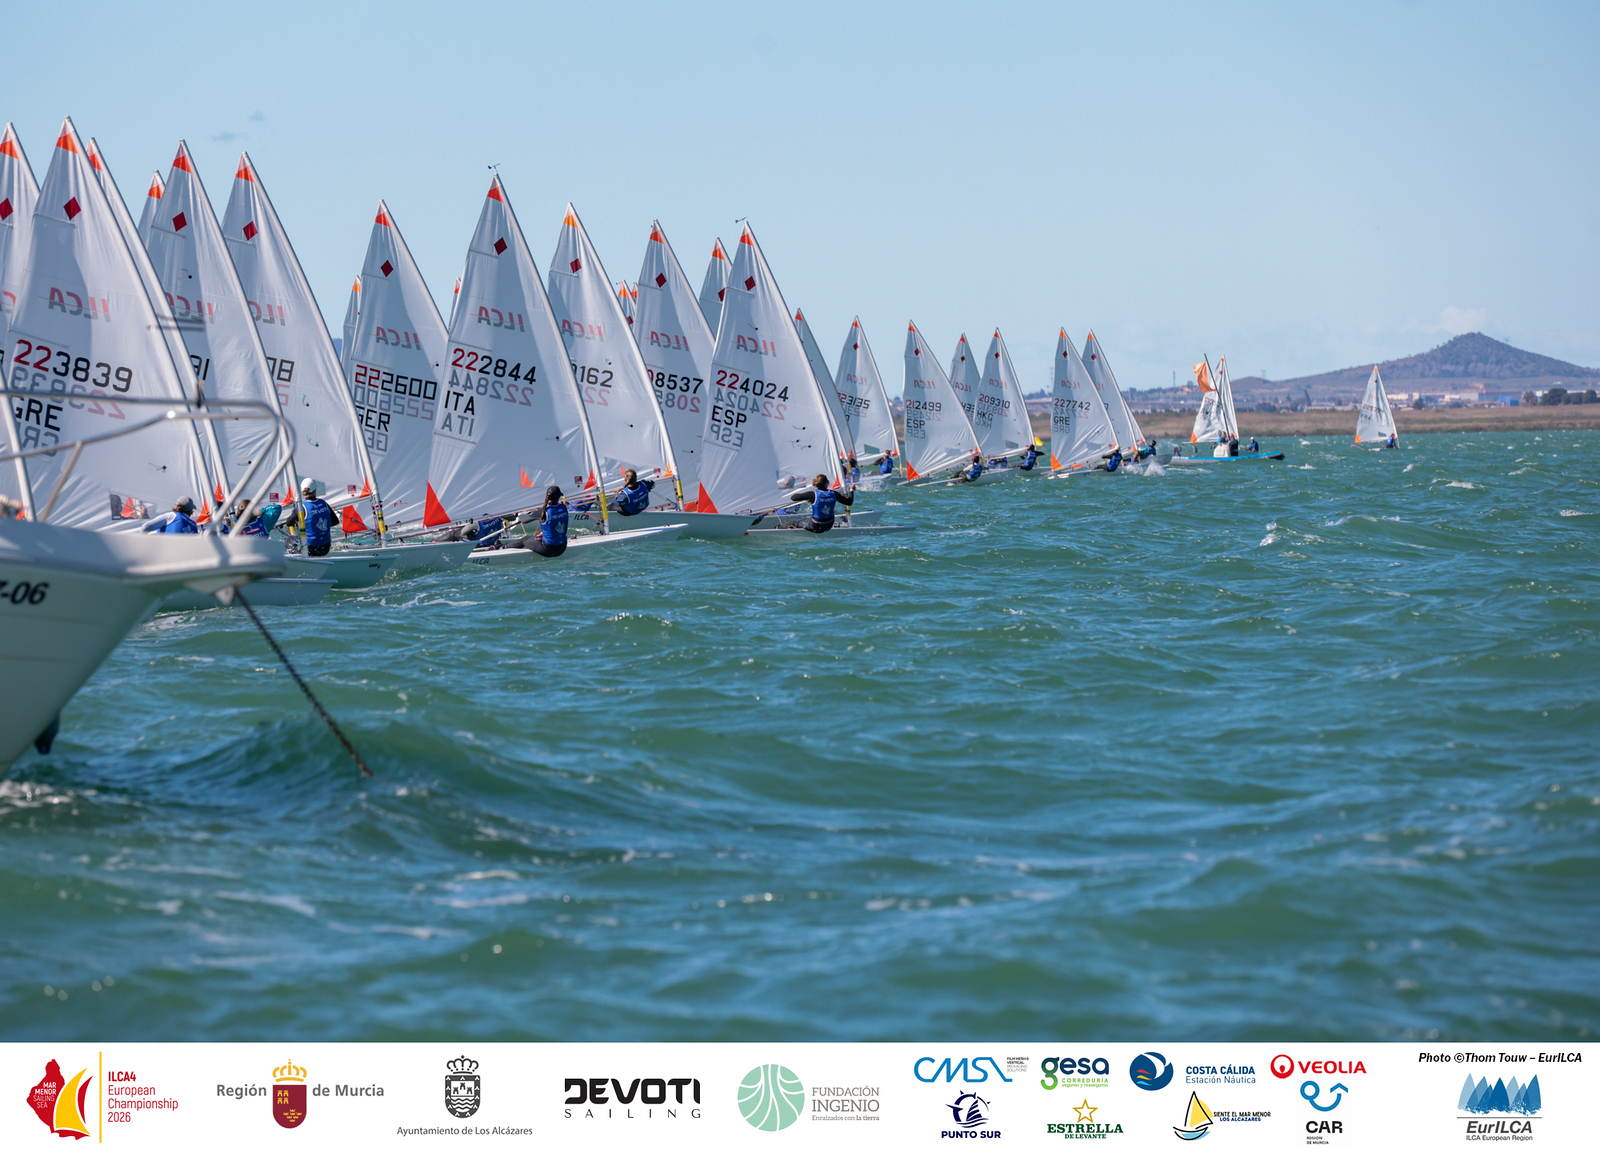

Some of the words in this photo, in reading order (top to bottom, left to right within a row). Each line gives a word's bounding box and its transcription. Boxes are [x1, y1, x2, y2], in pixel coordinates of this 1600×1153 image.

[13, 339, 133, 392] 223839
[451, 348, 537, 385] 222844
[355, 364, 438, 400] 222600
[716, 370, 789, 402] 224024
[444, 390, 475, 415] ITA
[906, 399, 942, 412] 212499
[978, 393, 1011, 409] 209310
[1054, 398, 1091, 411] 227742
[711, 405, 747, 428] ESP
[906, 418, 926, 429] ESP
[976, 410, 994, 422] HKG
[1053, 415, 1071, 426] GRE
